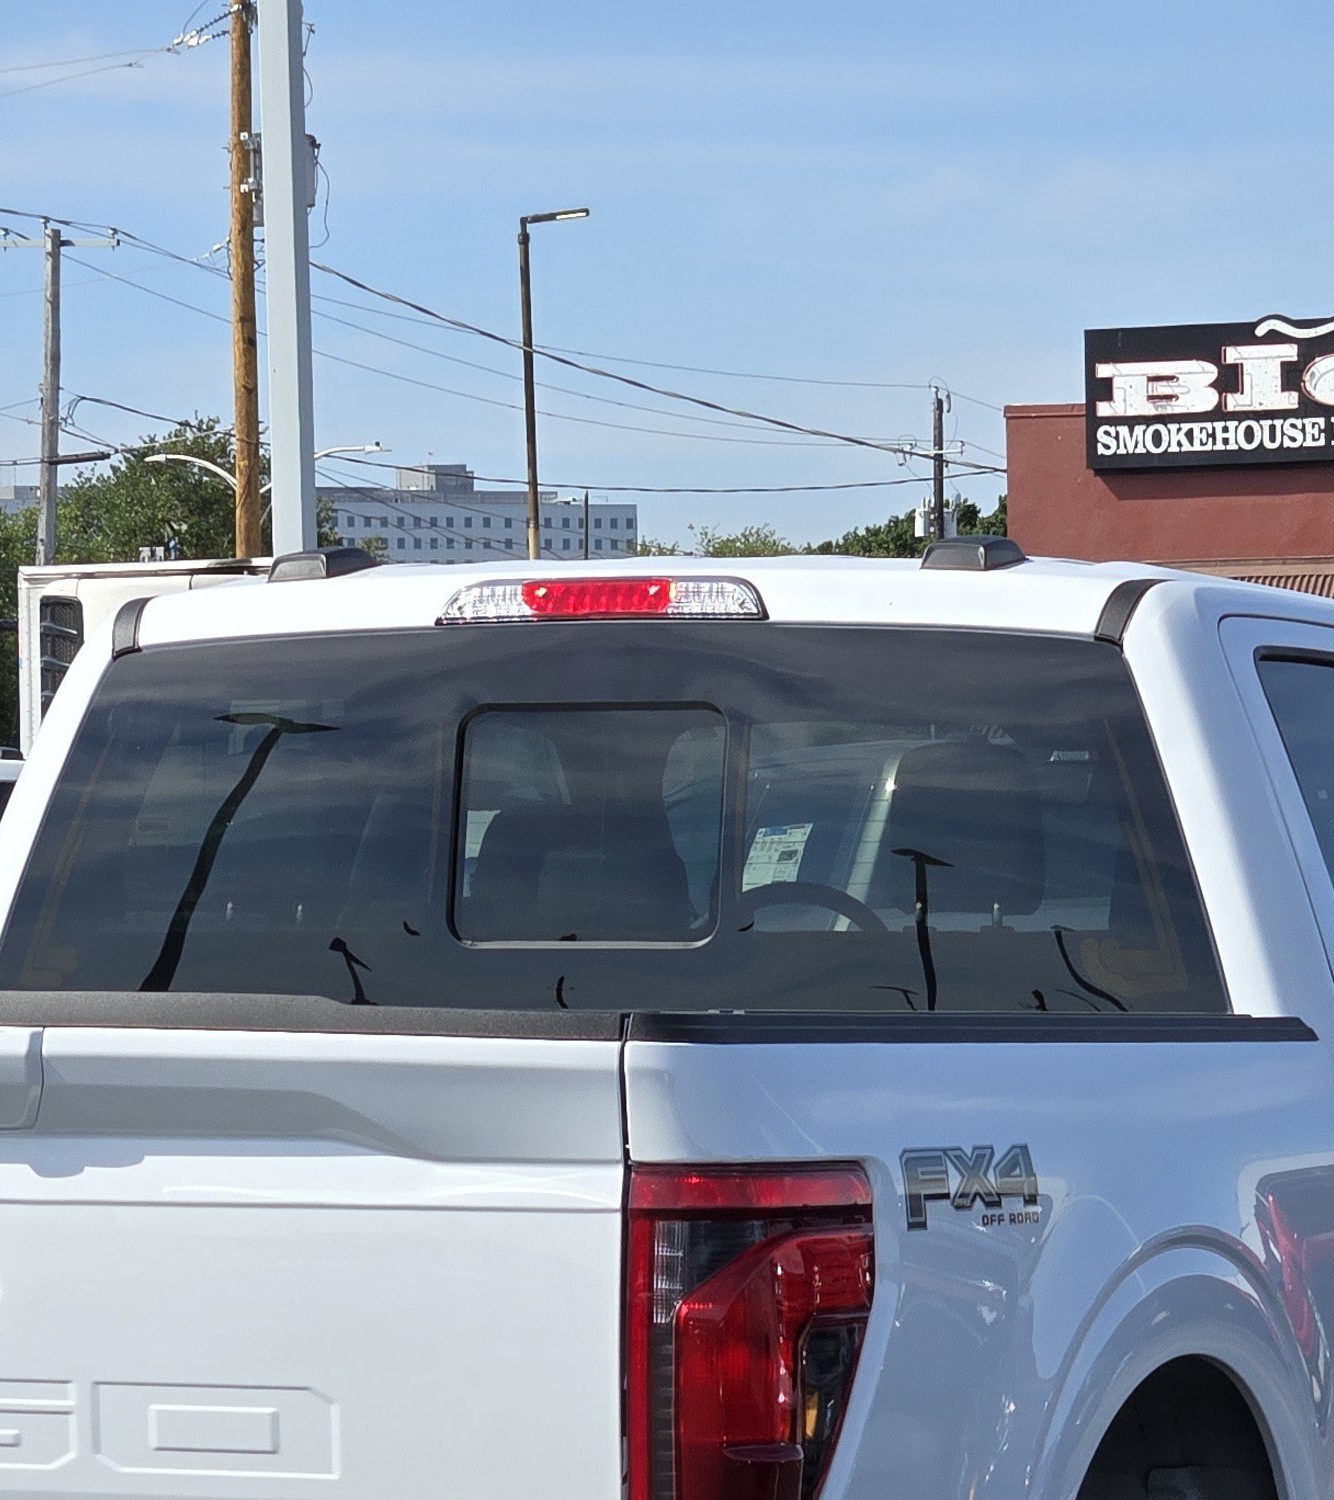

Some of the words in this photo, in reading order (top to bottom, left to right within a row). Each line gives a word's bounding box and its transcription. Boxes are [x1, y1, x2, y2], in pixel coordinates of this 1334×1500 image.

[1096, 418, 1326, 456] SMOKEHOUSE
[899, 1143, 1039, 1231] FX4
[981, 1213, 1005, 1226] OFF
[1010, 1211, 1040, 1225] ROAD
